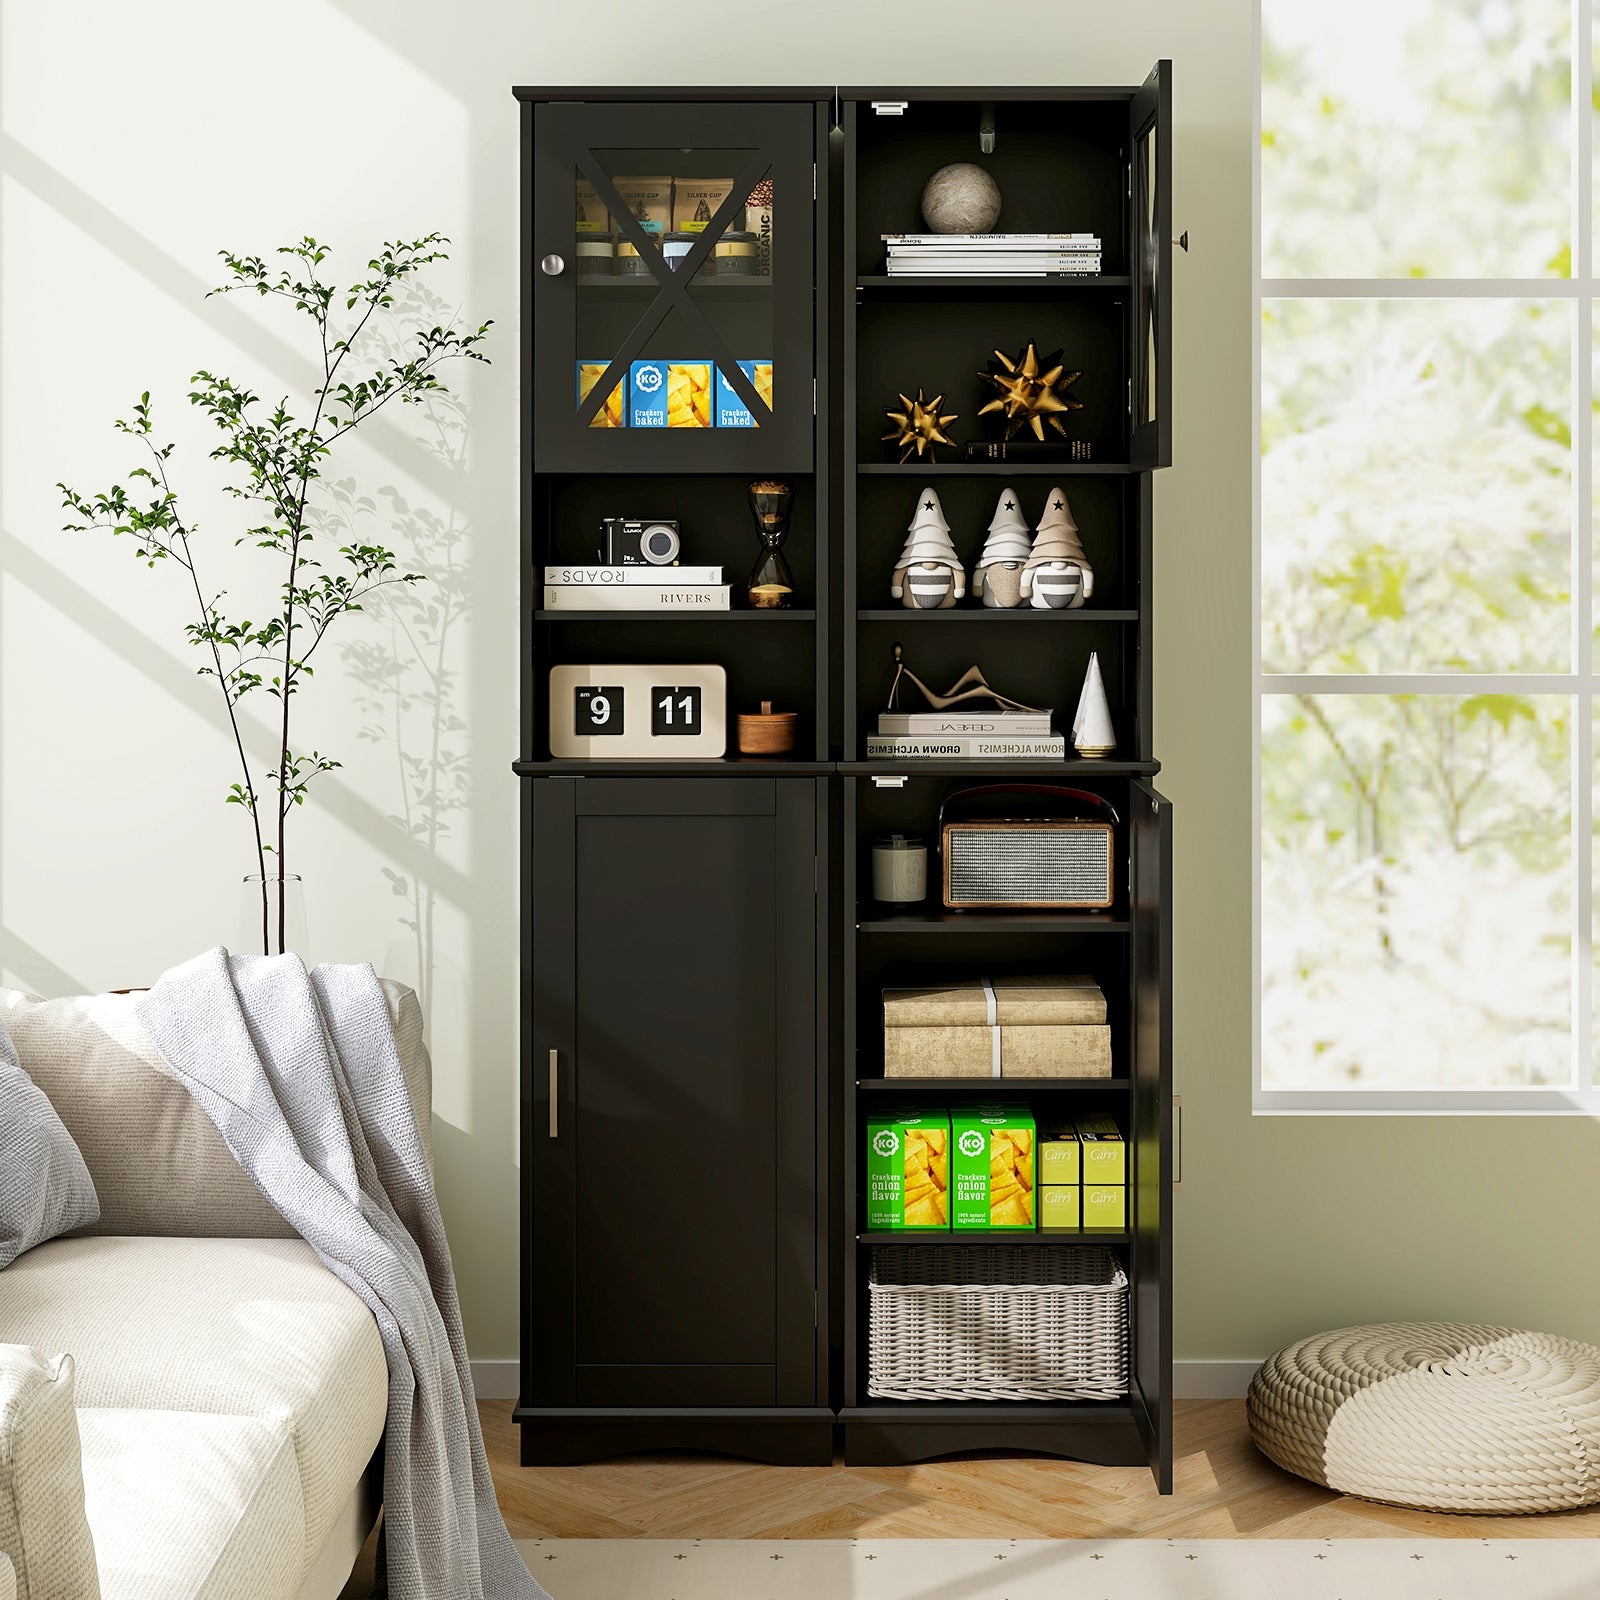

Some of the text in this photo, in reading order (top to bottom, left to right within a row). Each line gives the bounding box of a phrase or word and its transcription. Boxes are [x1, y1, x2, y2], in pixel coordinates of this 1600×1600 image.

[641, 375, 659, 384] KO
[635, 415, 664, 426] baked
[721, 415, 751, 426] baked
[562, 570, 625, 582] ROADS
[660, 594, 712, 603] RIVERS
[590, 695, 693, 725] 9 11
[879, 1139, 896, 1149] KO
[964, 1139, 982, 1149] KO
[1044, 1148, 1072, 1161] Carr's
[1090, 1148, 1118, 1161] Carr's
[871, 1181, 900, 1191] onion
[957, 1181, 986, 1191] onion
[871, 1191, 900, 1200] flavor
[957, 1191, 986, 1200] flavor
[1044, 1191, 1072, 1204] Carr's
[1090, 1191, 1118, 1204] Carr's
